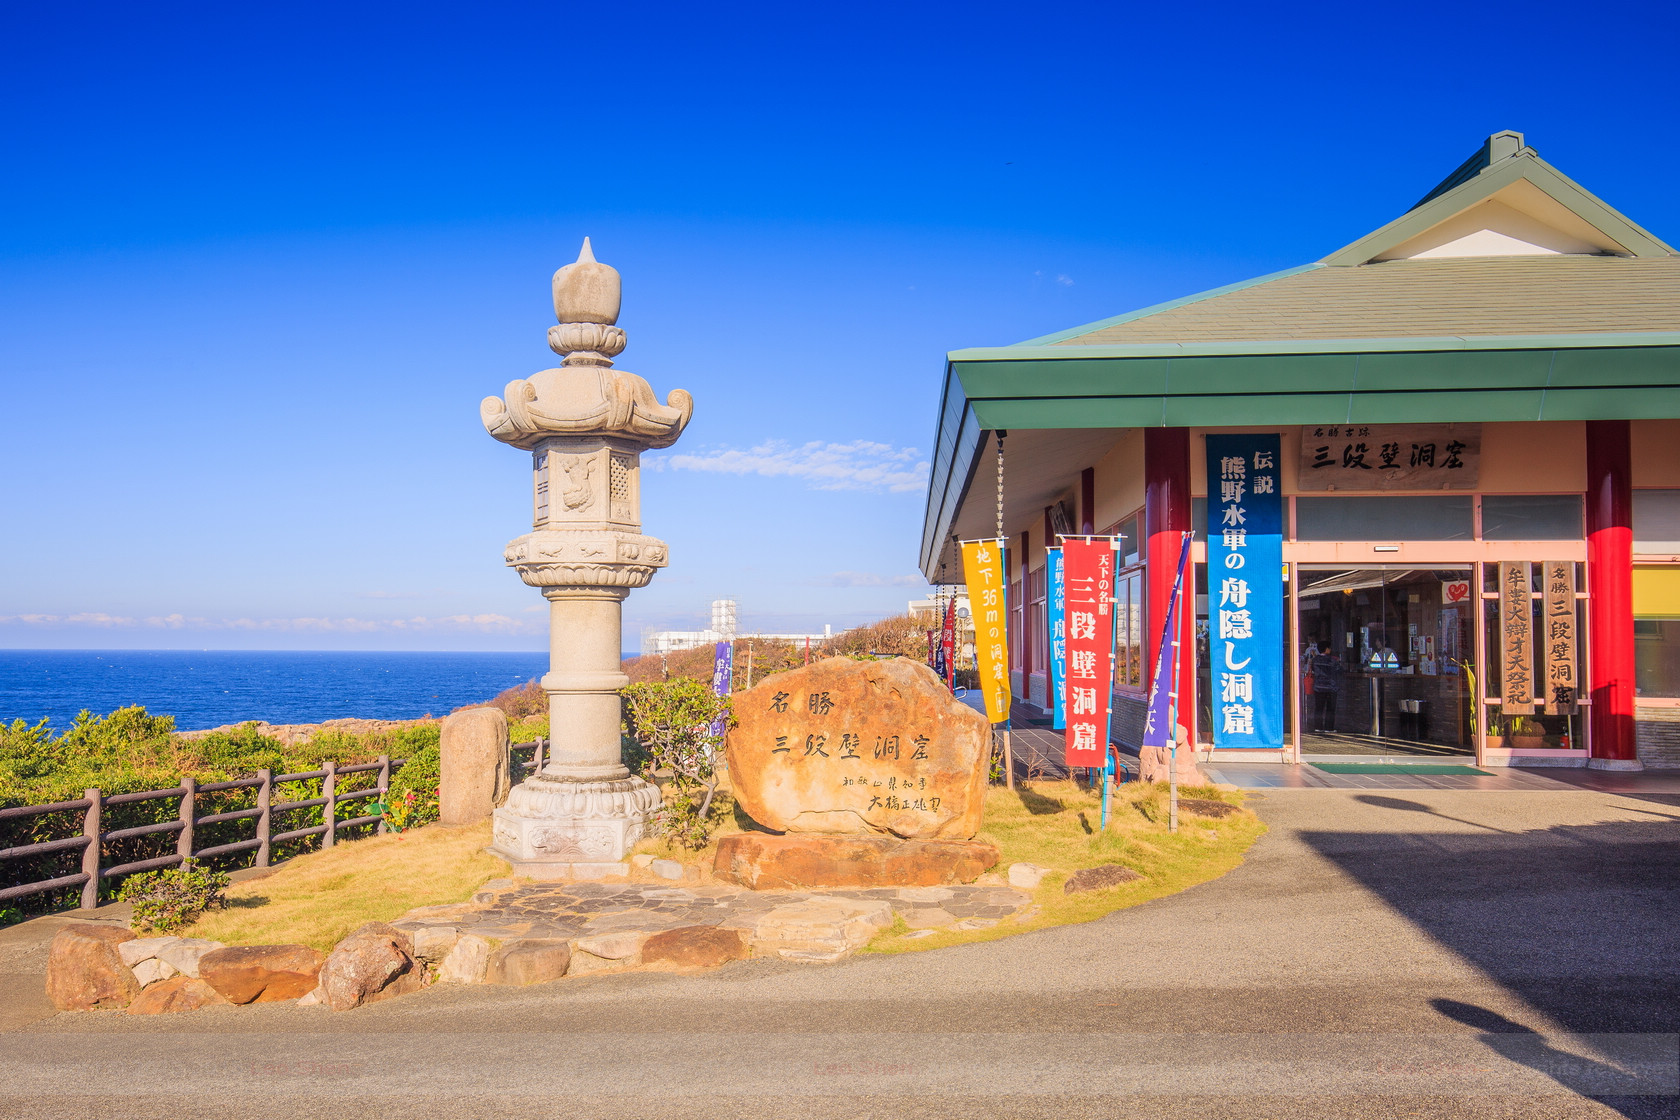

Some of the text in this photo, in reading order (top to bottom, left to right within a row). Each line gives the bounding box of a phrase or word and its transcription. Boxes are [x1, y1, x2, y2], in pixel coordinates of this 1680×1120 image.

[1253, 451, 1274, 494] 伝説
[1312, 440, 1467, 470] 三段壁洞窟
[1098, 554, 1110, 616] 天下の名勝
[1070, 576, 1097, 751] 三段壁洞窟
[768, 691, 835, 715] 名勝
[771, 733, 930, 760] 三段壁洞窟
